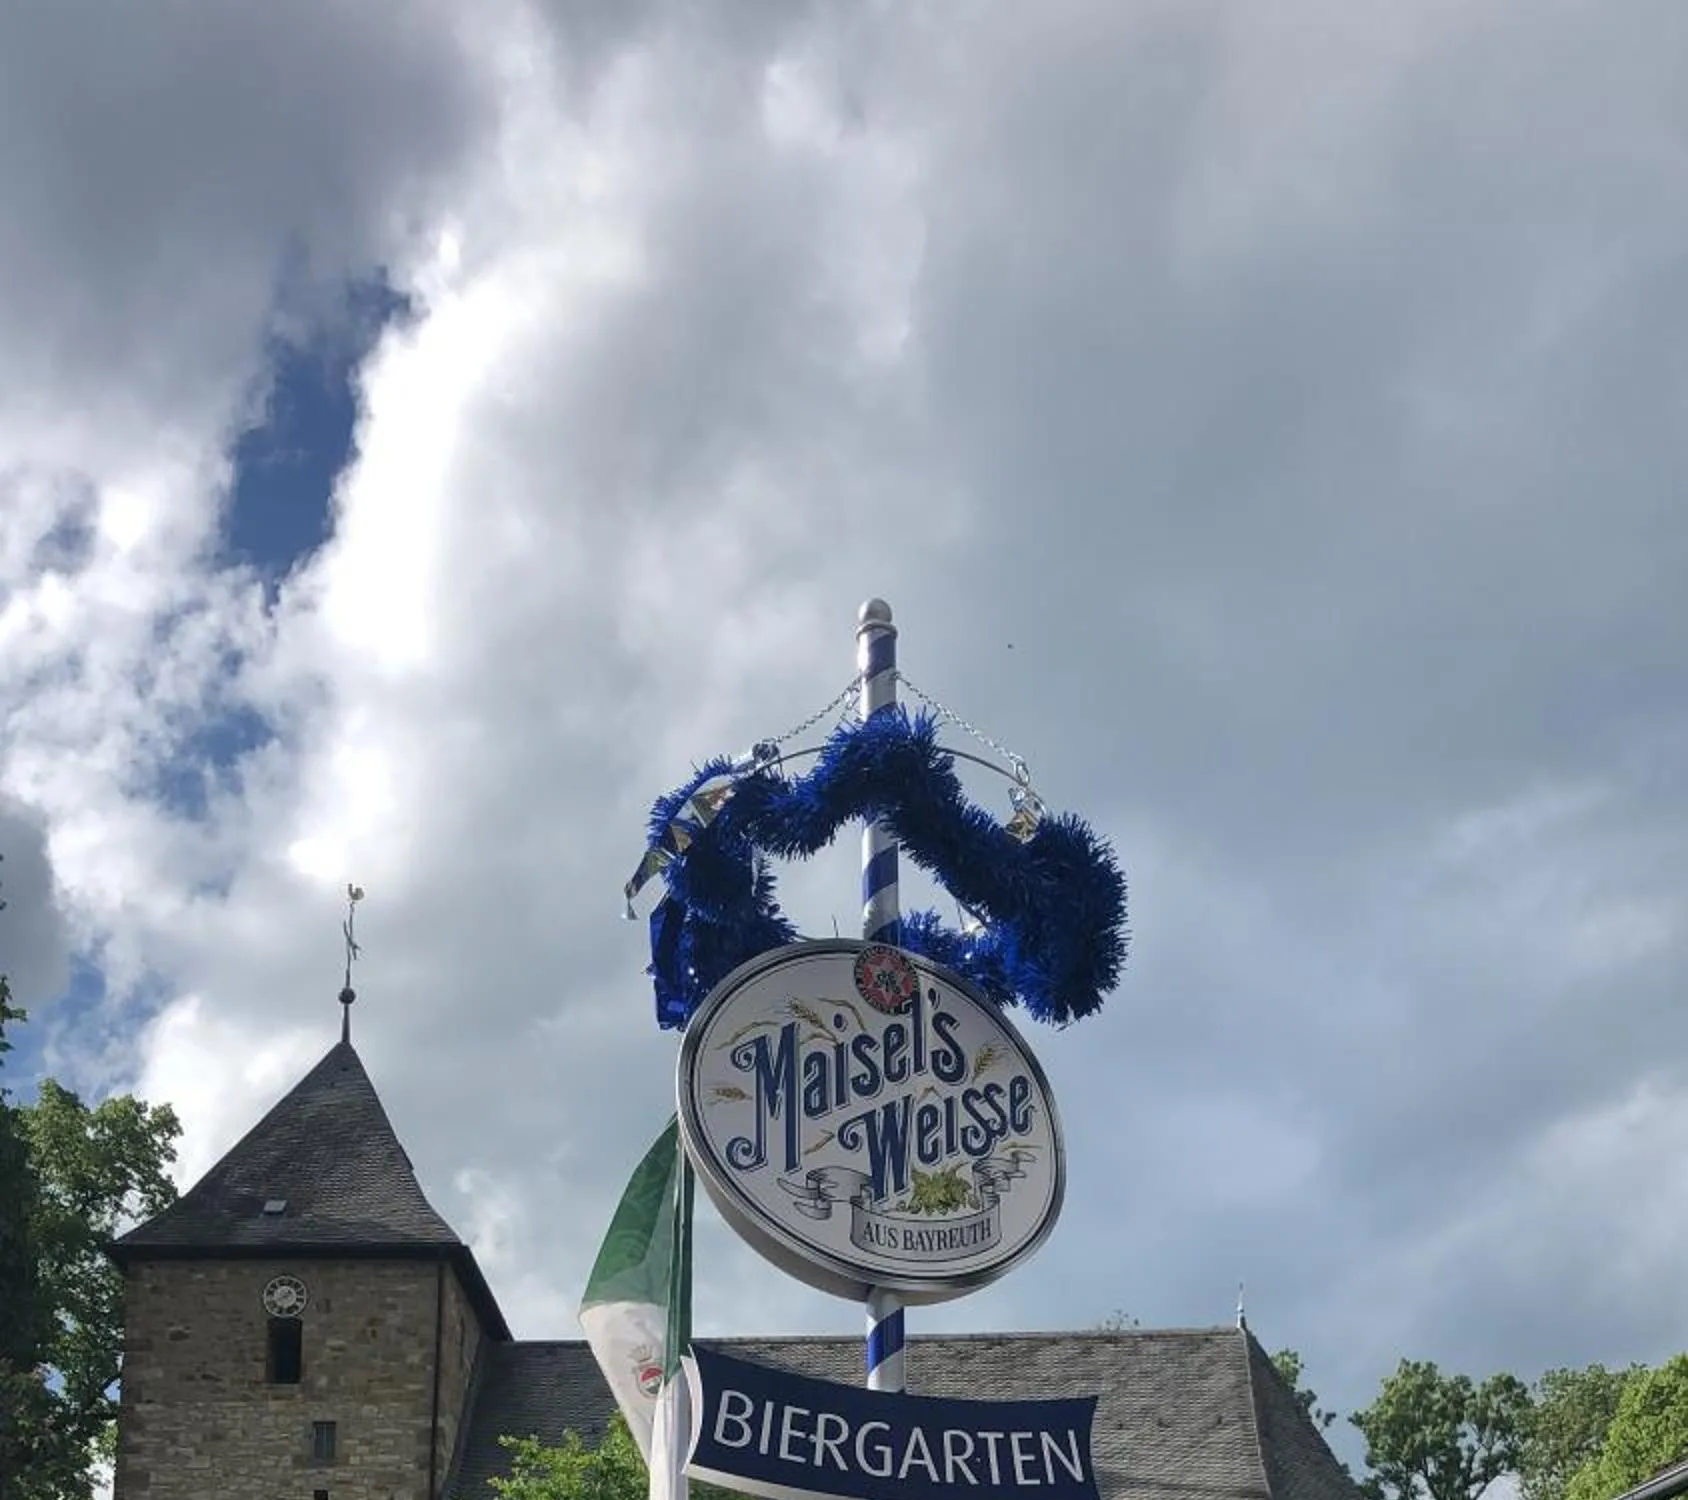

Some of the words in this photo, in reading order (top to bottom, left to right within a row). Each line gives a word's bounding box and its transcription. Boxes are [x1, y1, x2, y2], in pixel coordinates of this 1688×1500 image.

[725, 986, 968, 1175] Maisel's
[837, 1073, 1036, 1203] Weisse
[863, 1220, 899, 1249] AUS
[902, 1217, 992, 1252] BAYREUTH
[713, 1389, 1084, 1486] BIERGARTEN
